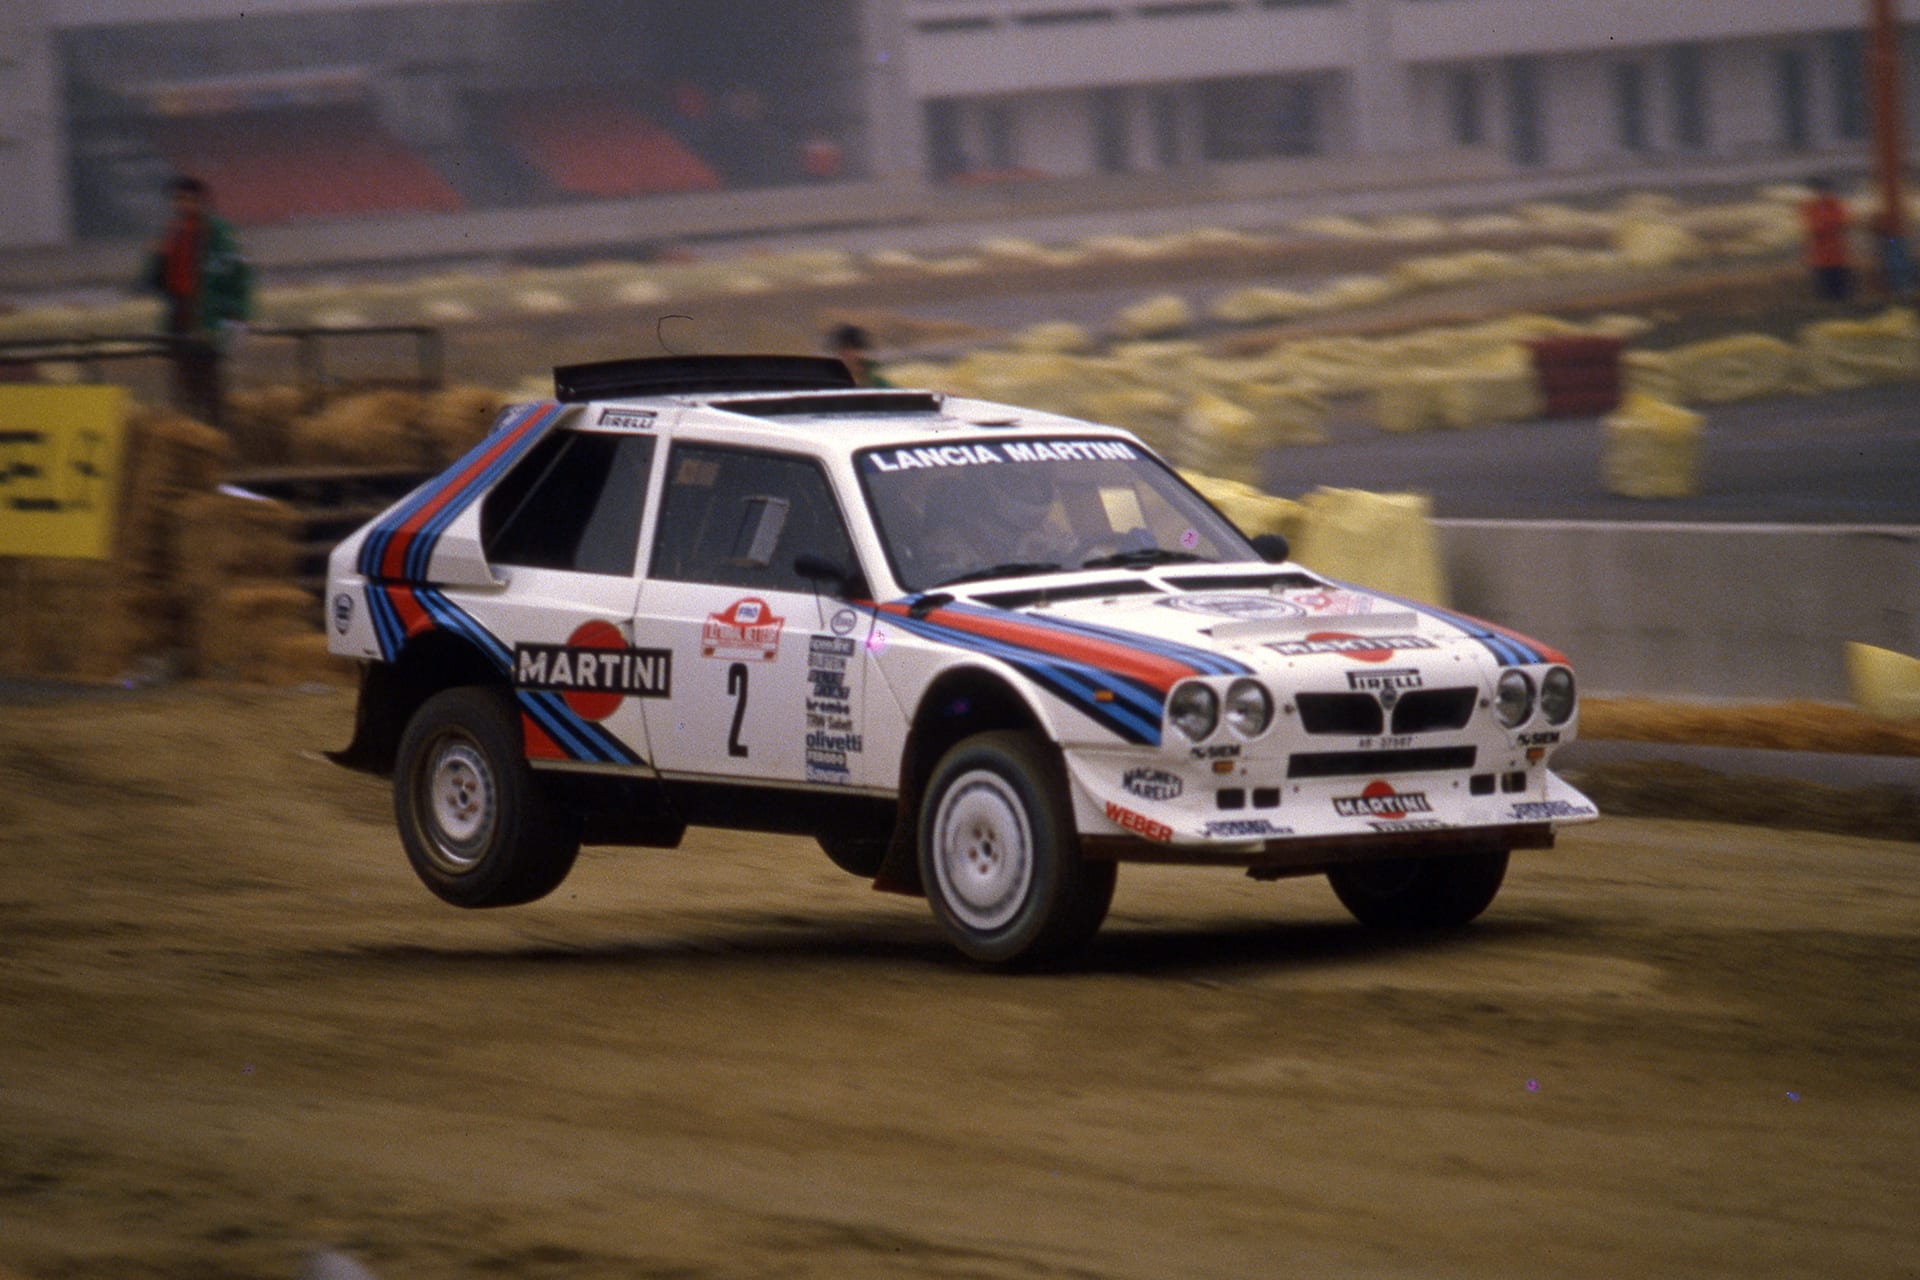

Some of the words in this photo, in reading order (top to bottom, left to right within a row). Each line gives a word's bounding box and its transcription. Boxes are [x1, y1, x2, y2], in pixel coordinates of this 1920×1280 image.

[869, 443, 1003, 473] LANCIA
[1002, 440, 1138, 463] MARTINI
[518, 650, 666, 690] MARTINI
[1346, 668, 1423, 690] PIRELLI
[728, 663, 748, 757] 2
[806, 731, 863, 753] olivetti
[1335, 795, 1430, 816] MARTINI
[1105, 801, 1174, 844] WEBER
